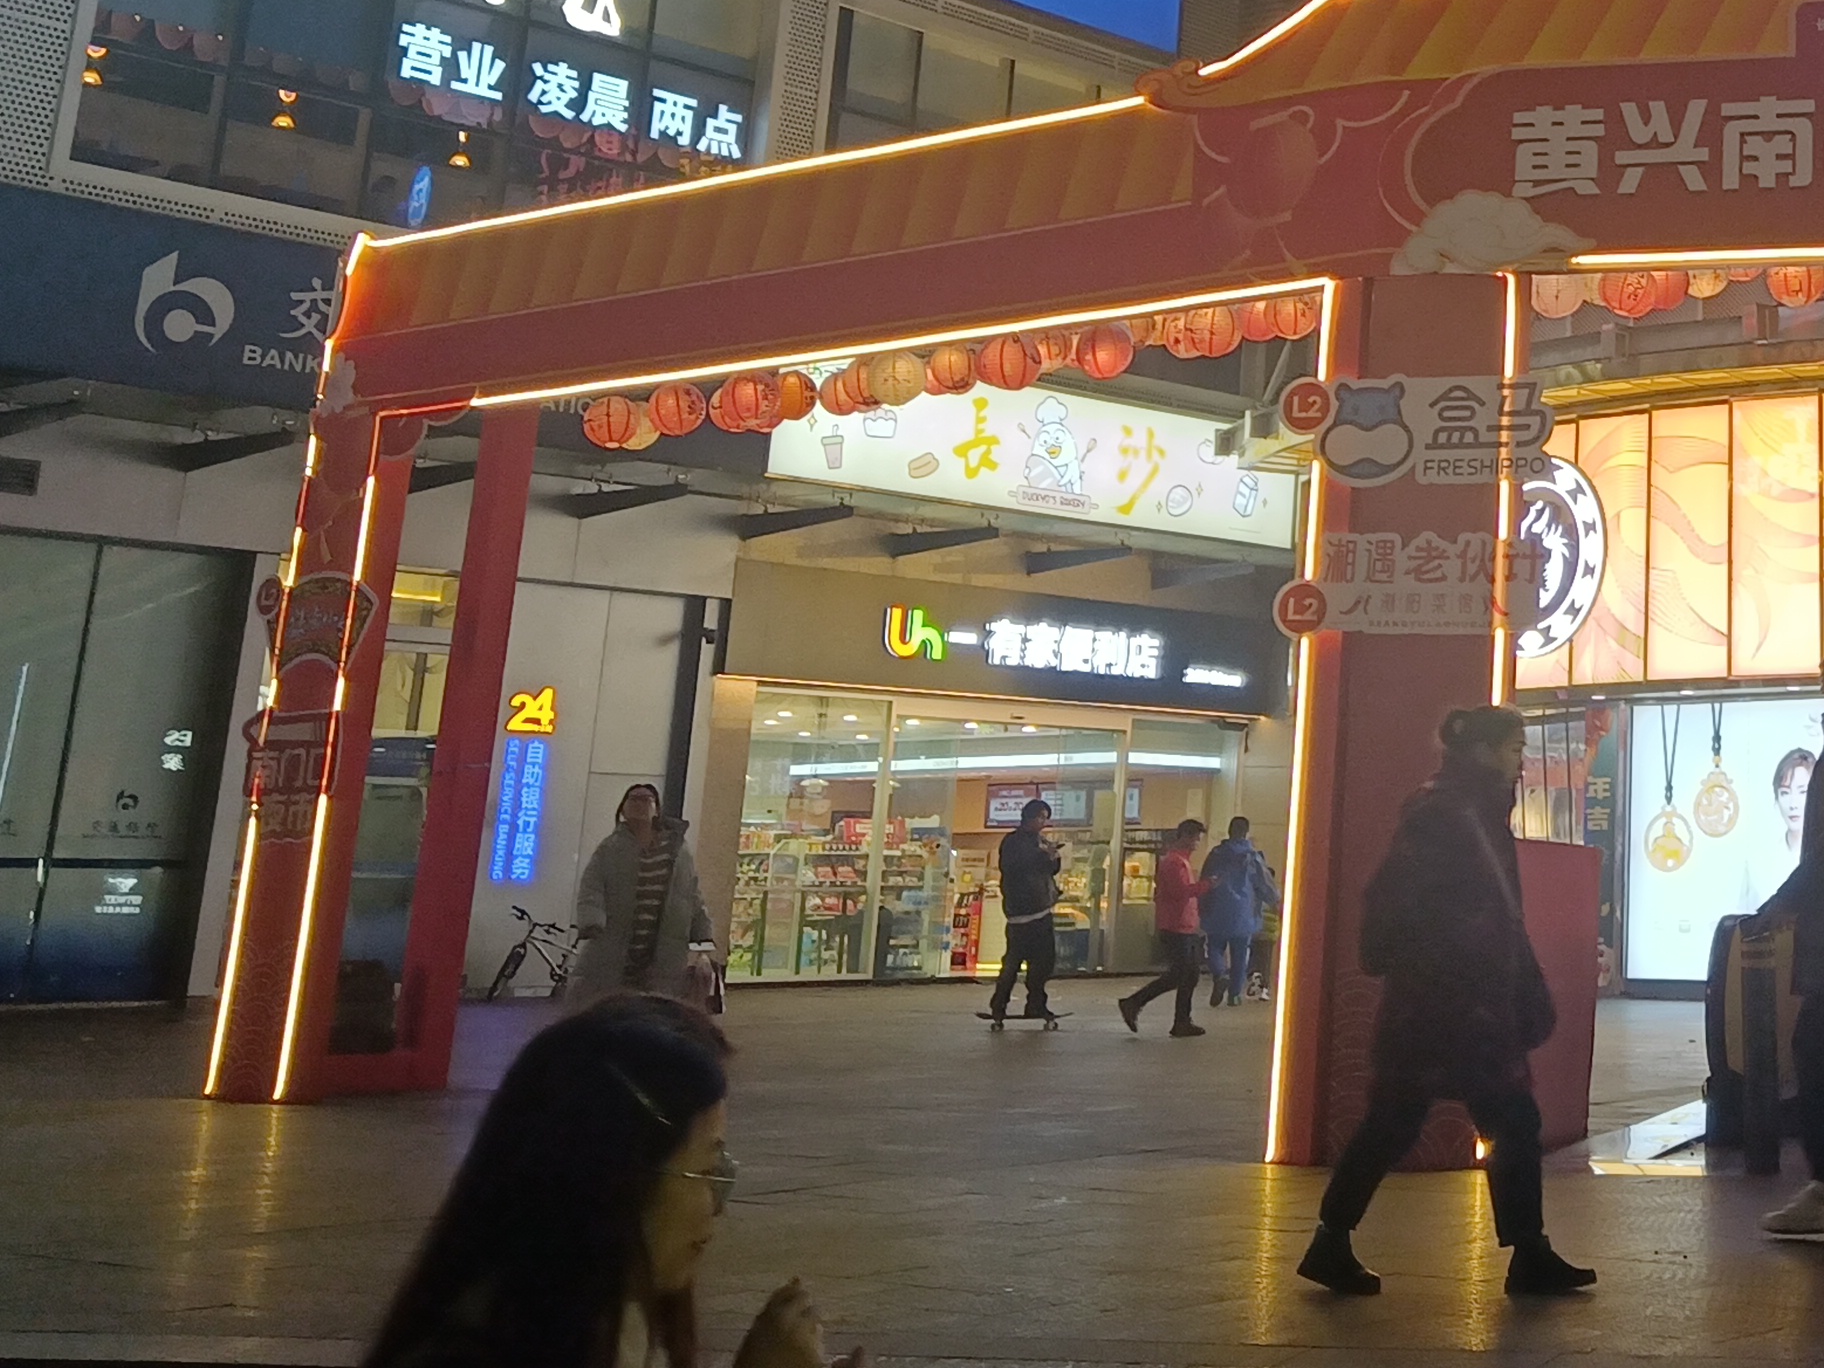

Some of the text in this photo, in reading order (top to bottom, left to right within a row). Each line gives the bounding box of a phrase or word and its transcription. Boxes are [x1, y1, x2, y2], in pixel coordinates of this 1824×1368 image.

[397, 21, 745, 162] 营业 凌晨 两点
[1289, 395, 1322, 418] L2
[1423, 380, 1550, 451] 盒马
[1422, 456, 1546, 477] FRESHIPPO
[1323, 537, 1546, 586] 湘遇老伙计
[1287, 595, 1320, 621] L2
[507, 687, 556, 733] 24
[510, 739, 545, 880] 自助银行服务
